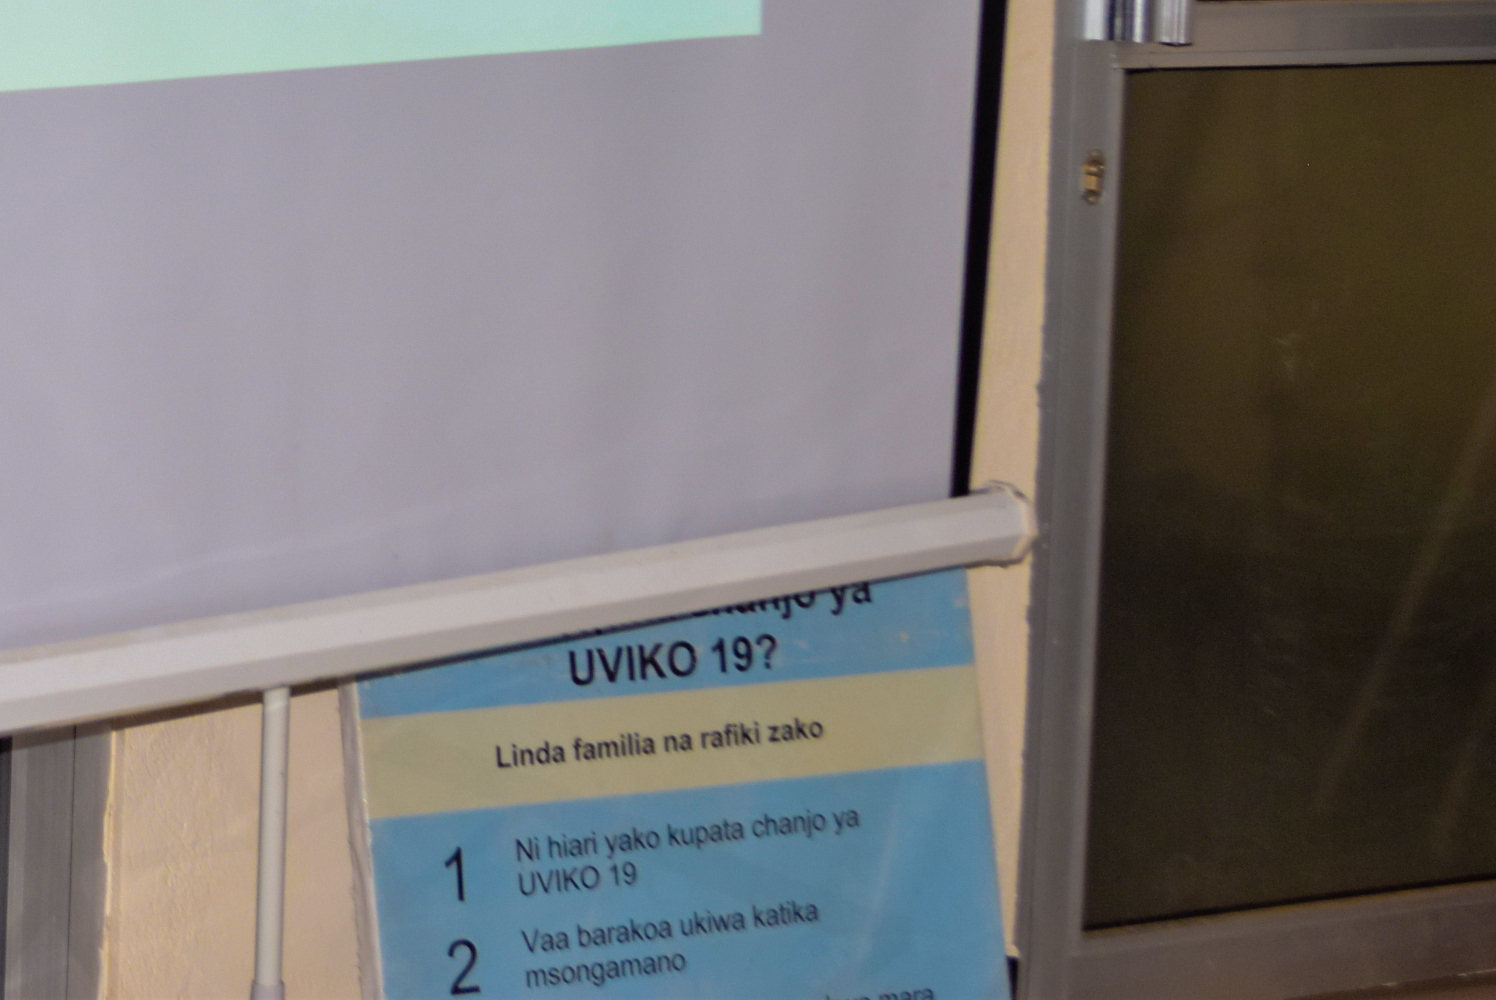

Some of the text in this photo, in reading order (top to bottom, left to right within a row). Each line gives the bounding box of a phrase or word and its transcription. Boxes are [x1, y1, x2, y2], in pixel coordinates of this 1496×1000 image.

[569, 633, 778, 686] UVIKO 19?
[496, 718, 825, 769] Linda familia na rafiki zako
[515, 808, 861, 862] Ni hiari yako kupata chanjo ya
[444, 846, 466, 902] 1
[518, 861, 638, 897] UVIKO 19
[520, 900, 820, 954] Vaa barakoa ukiwa katika
[447, 938, 481, 996] 2
[525, 951, 687, 987] msongamano
